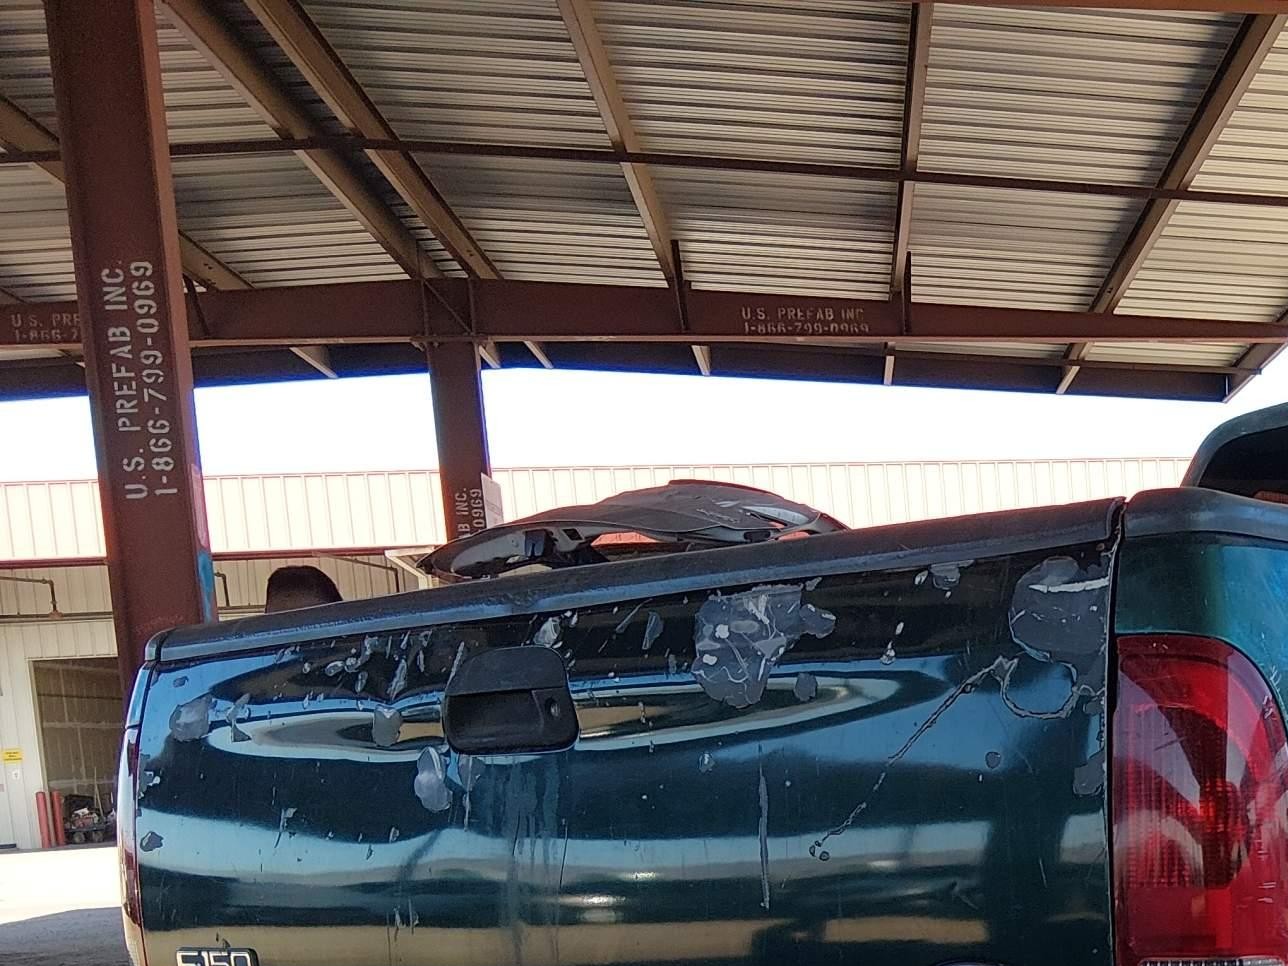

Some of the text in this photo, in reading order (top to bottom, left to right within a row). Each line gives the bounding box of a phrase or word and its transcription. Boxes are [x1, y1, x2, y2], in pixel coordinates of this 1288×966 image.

[742, 306, 770, 320] U.S.
[777, 306, 834, 321] PREFAB
[107, 326, 141, 431] PREFAB
[130, 261, 178, 496] 1-866-799-0969
[124, 449, 148, 499] U.S.
